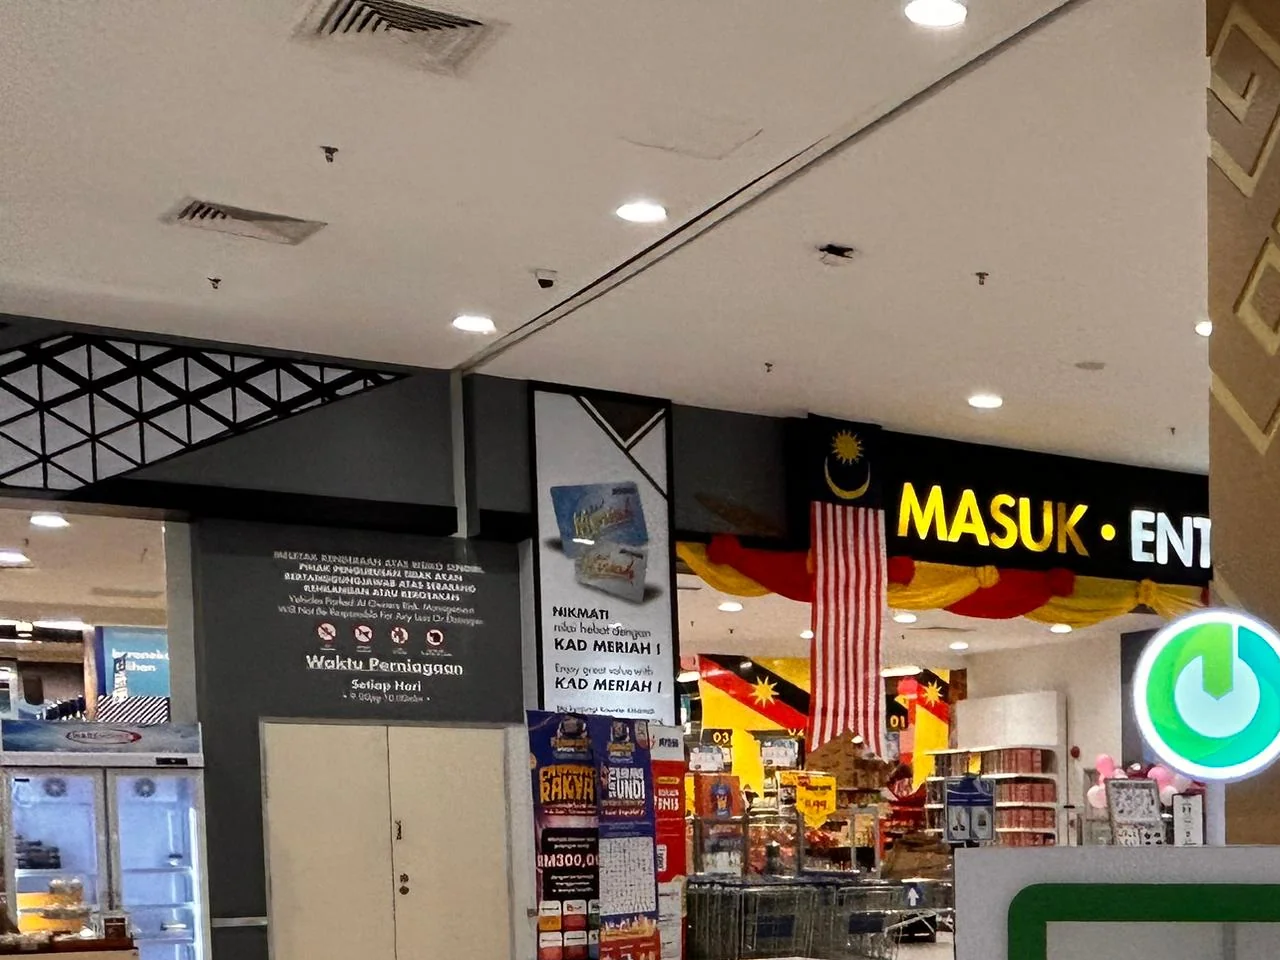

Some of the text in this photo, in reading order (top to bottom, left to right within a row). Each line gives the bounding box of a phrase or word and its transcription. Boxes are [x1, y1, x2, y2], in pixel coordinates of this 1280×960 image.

[897, 481, 1091, 557] MASUK
[552, 605, 609, 620] NIKMATI
[553, 637, 588, 652] KAD
[592, 639, 652, 656] MERIAH
[305, 653, 464, 677] Waktu Perniagaan
[350, 678, 422, 693] Setiap Hari
[554, 676, 589, 691] KAD
[592, 678, 653, 694] MERIAH
[712, 731, 730, 744] 03
